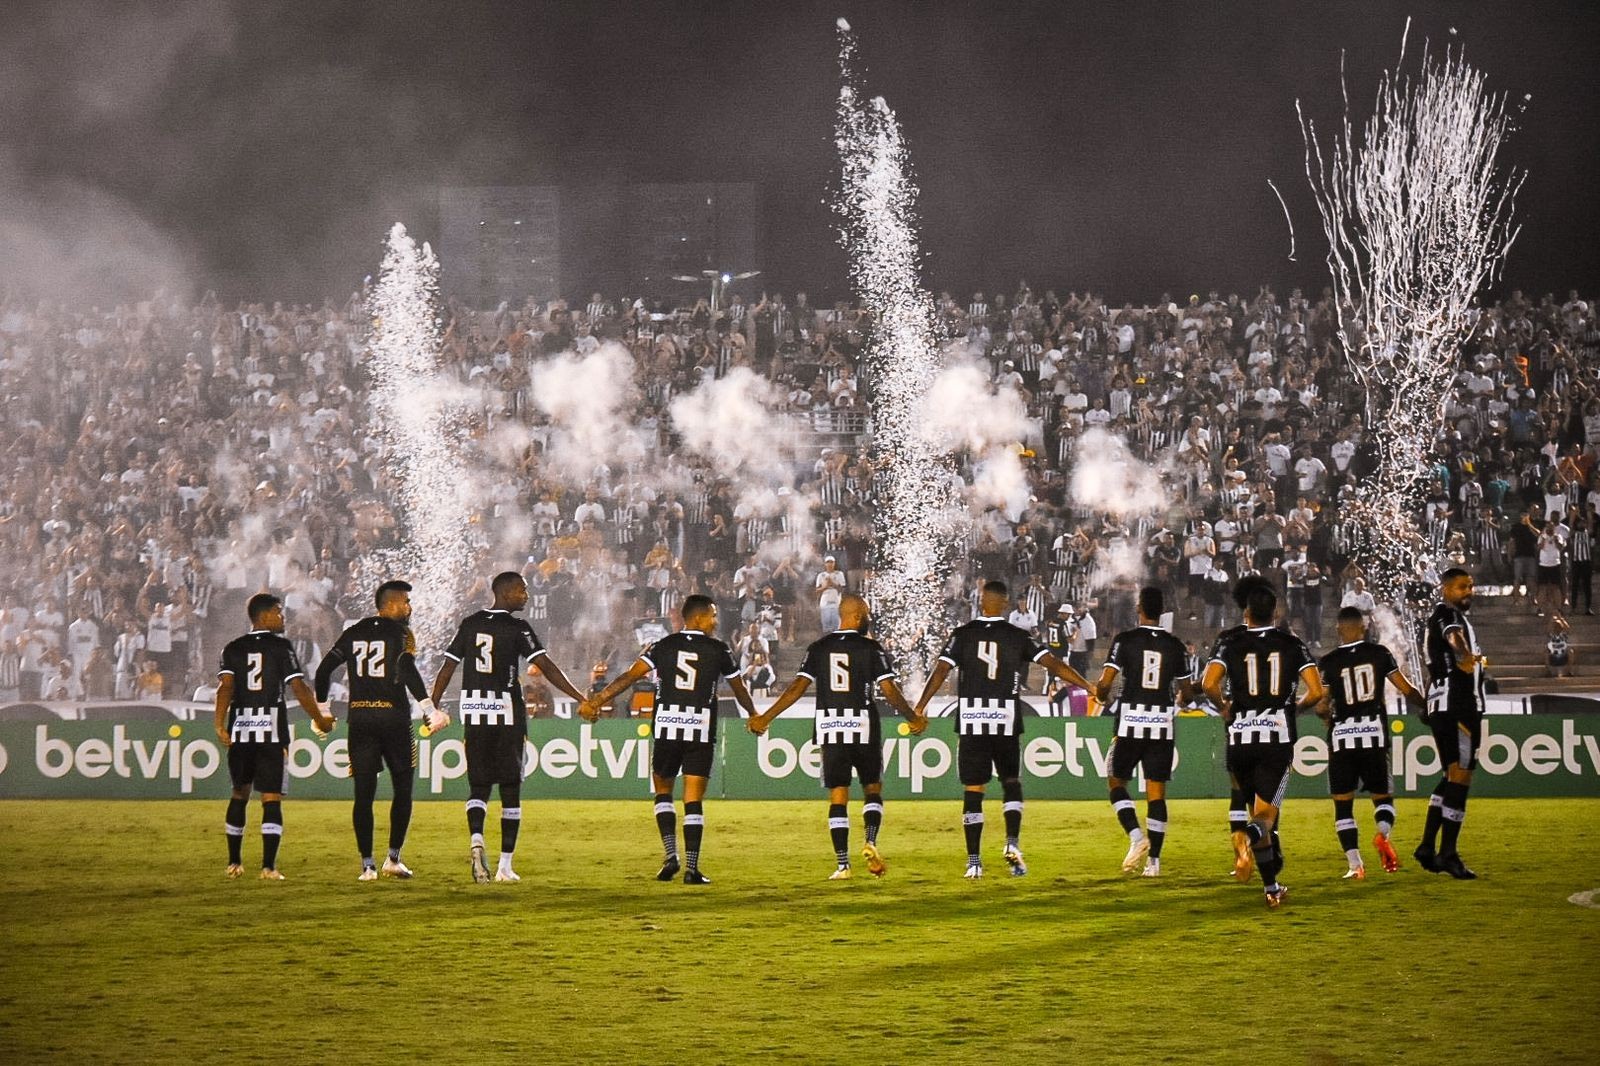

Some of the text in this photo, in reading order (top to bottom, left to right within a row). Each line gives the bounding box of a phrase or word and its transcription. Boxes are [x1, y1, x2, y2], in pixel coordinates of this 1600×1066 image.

[247, 652, 262, 691] 2
[352, 641, 385, 677] 72
[475, 633, 493, 674] 3
[675, 650, 699, 691] 5
[830, 653, 850, 692] 6
[977, 641, 998, 680] 4
[1142, 650, 1162, 690] 8
[1244, 652, 1279, 696] 11
[1340, 663, 1375, 705] 10
[350, 700, 388, 709] asatudo
[461, 702, 502, 711] casatudo
[657, 716, 700, 725] casatudo
[961, 711, 1003, 720] casatudo
[1124, 715, 1165, 724] casatudo
[820, 720, 858, 730] casatudo
[36, 724, 220, 793] betvip
[287, 724, 467, 793] beip
[523, 723, 656, 793] etvi
[758, 723, 952, 793] beip
